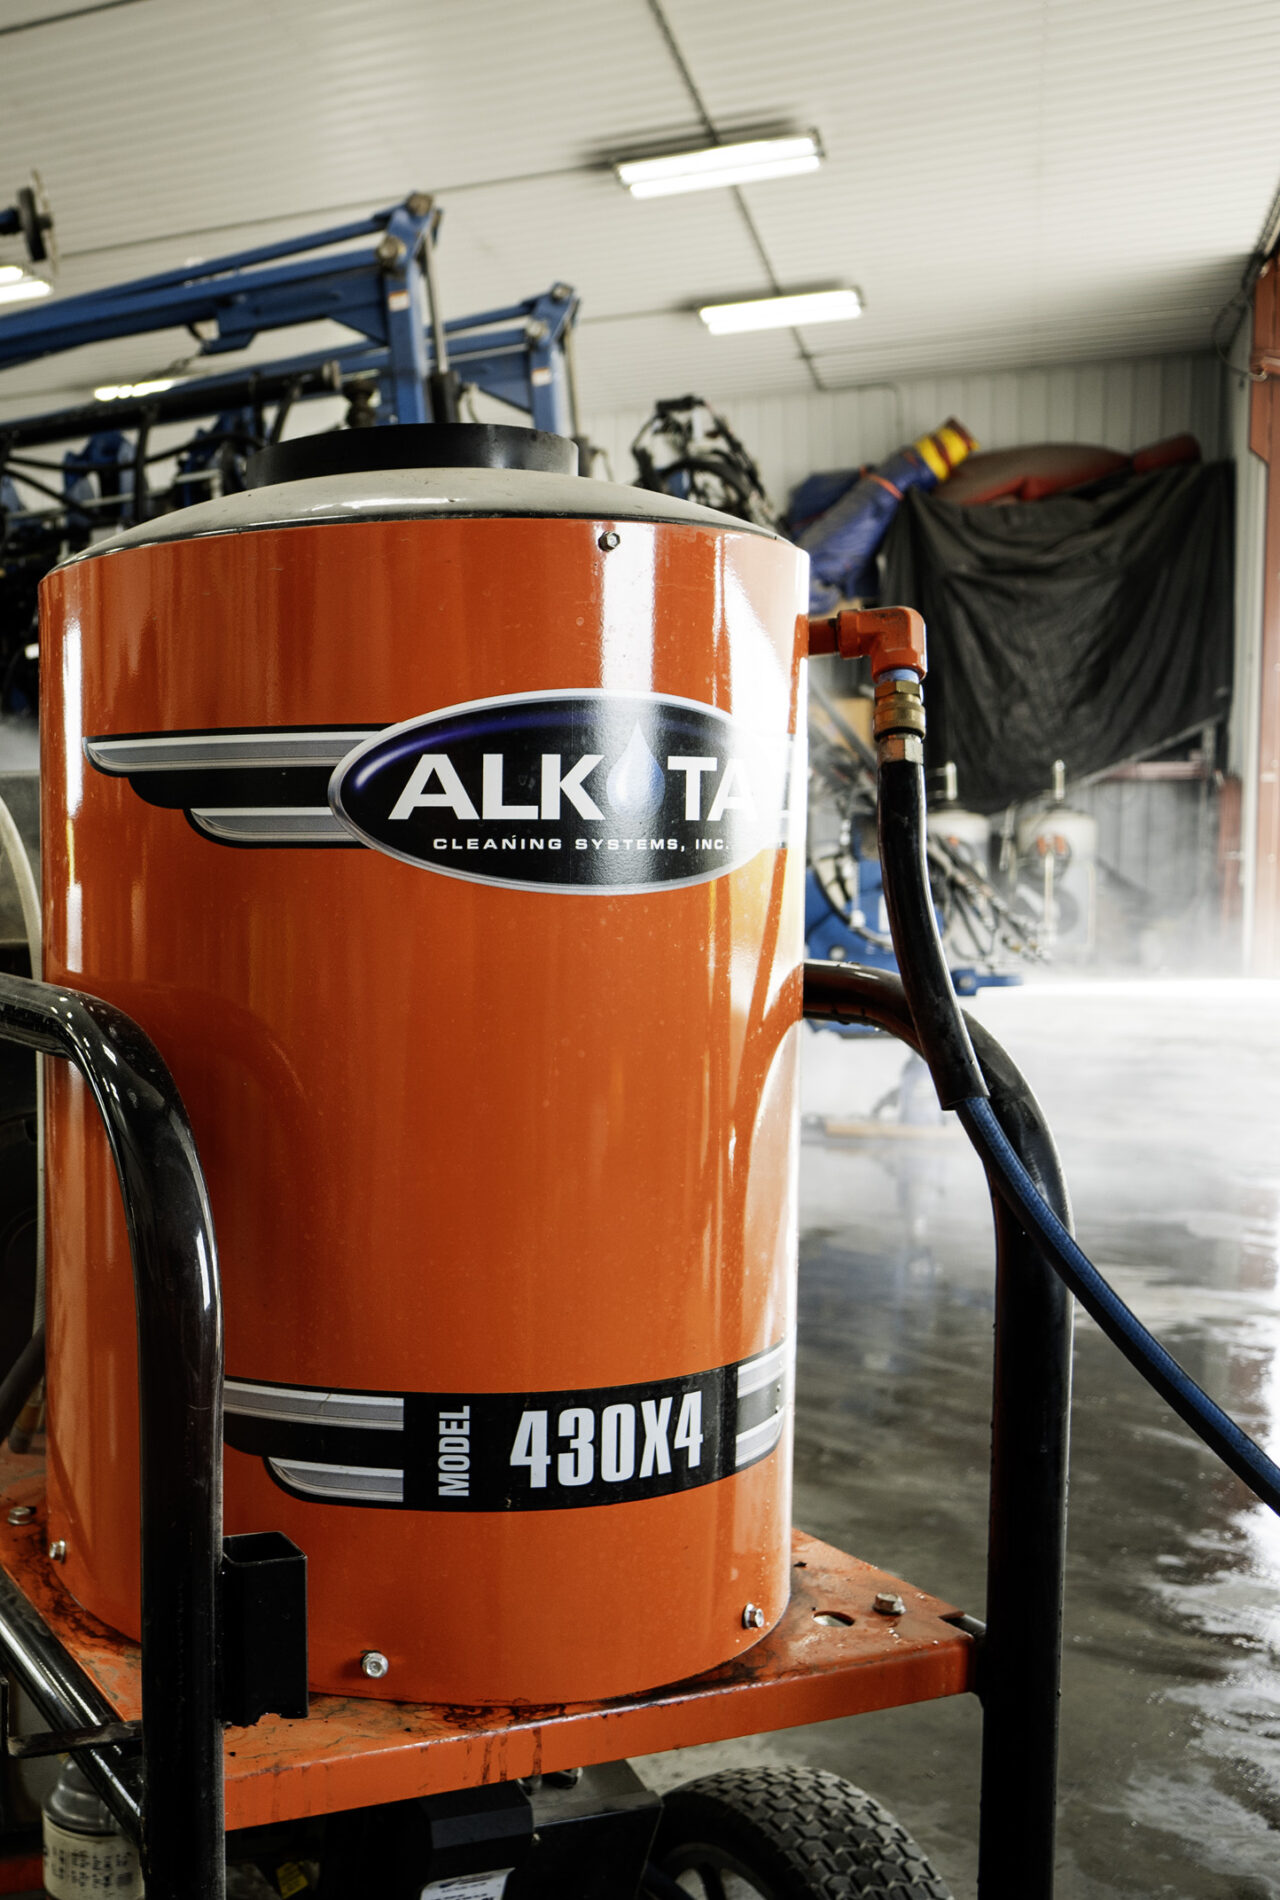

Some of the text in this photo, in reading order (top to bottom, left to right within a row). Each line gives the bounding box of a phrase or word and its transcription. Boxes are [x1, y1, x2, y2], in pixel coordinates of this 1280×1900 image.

[433, 838, 730, 853] CLEANING SYSTEMS, INC.
[438, 1405, 470, 1497] MODEL
[510, 1390, 703, 1489] 430X4
